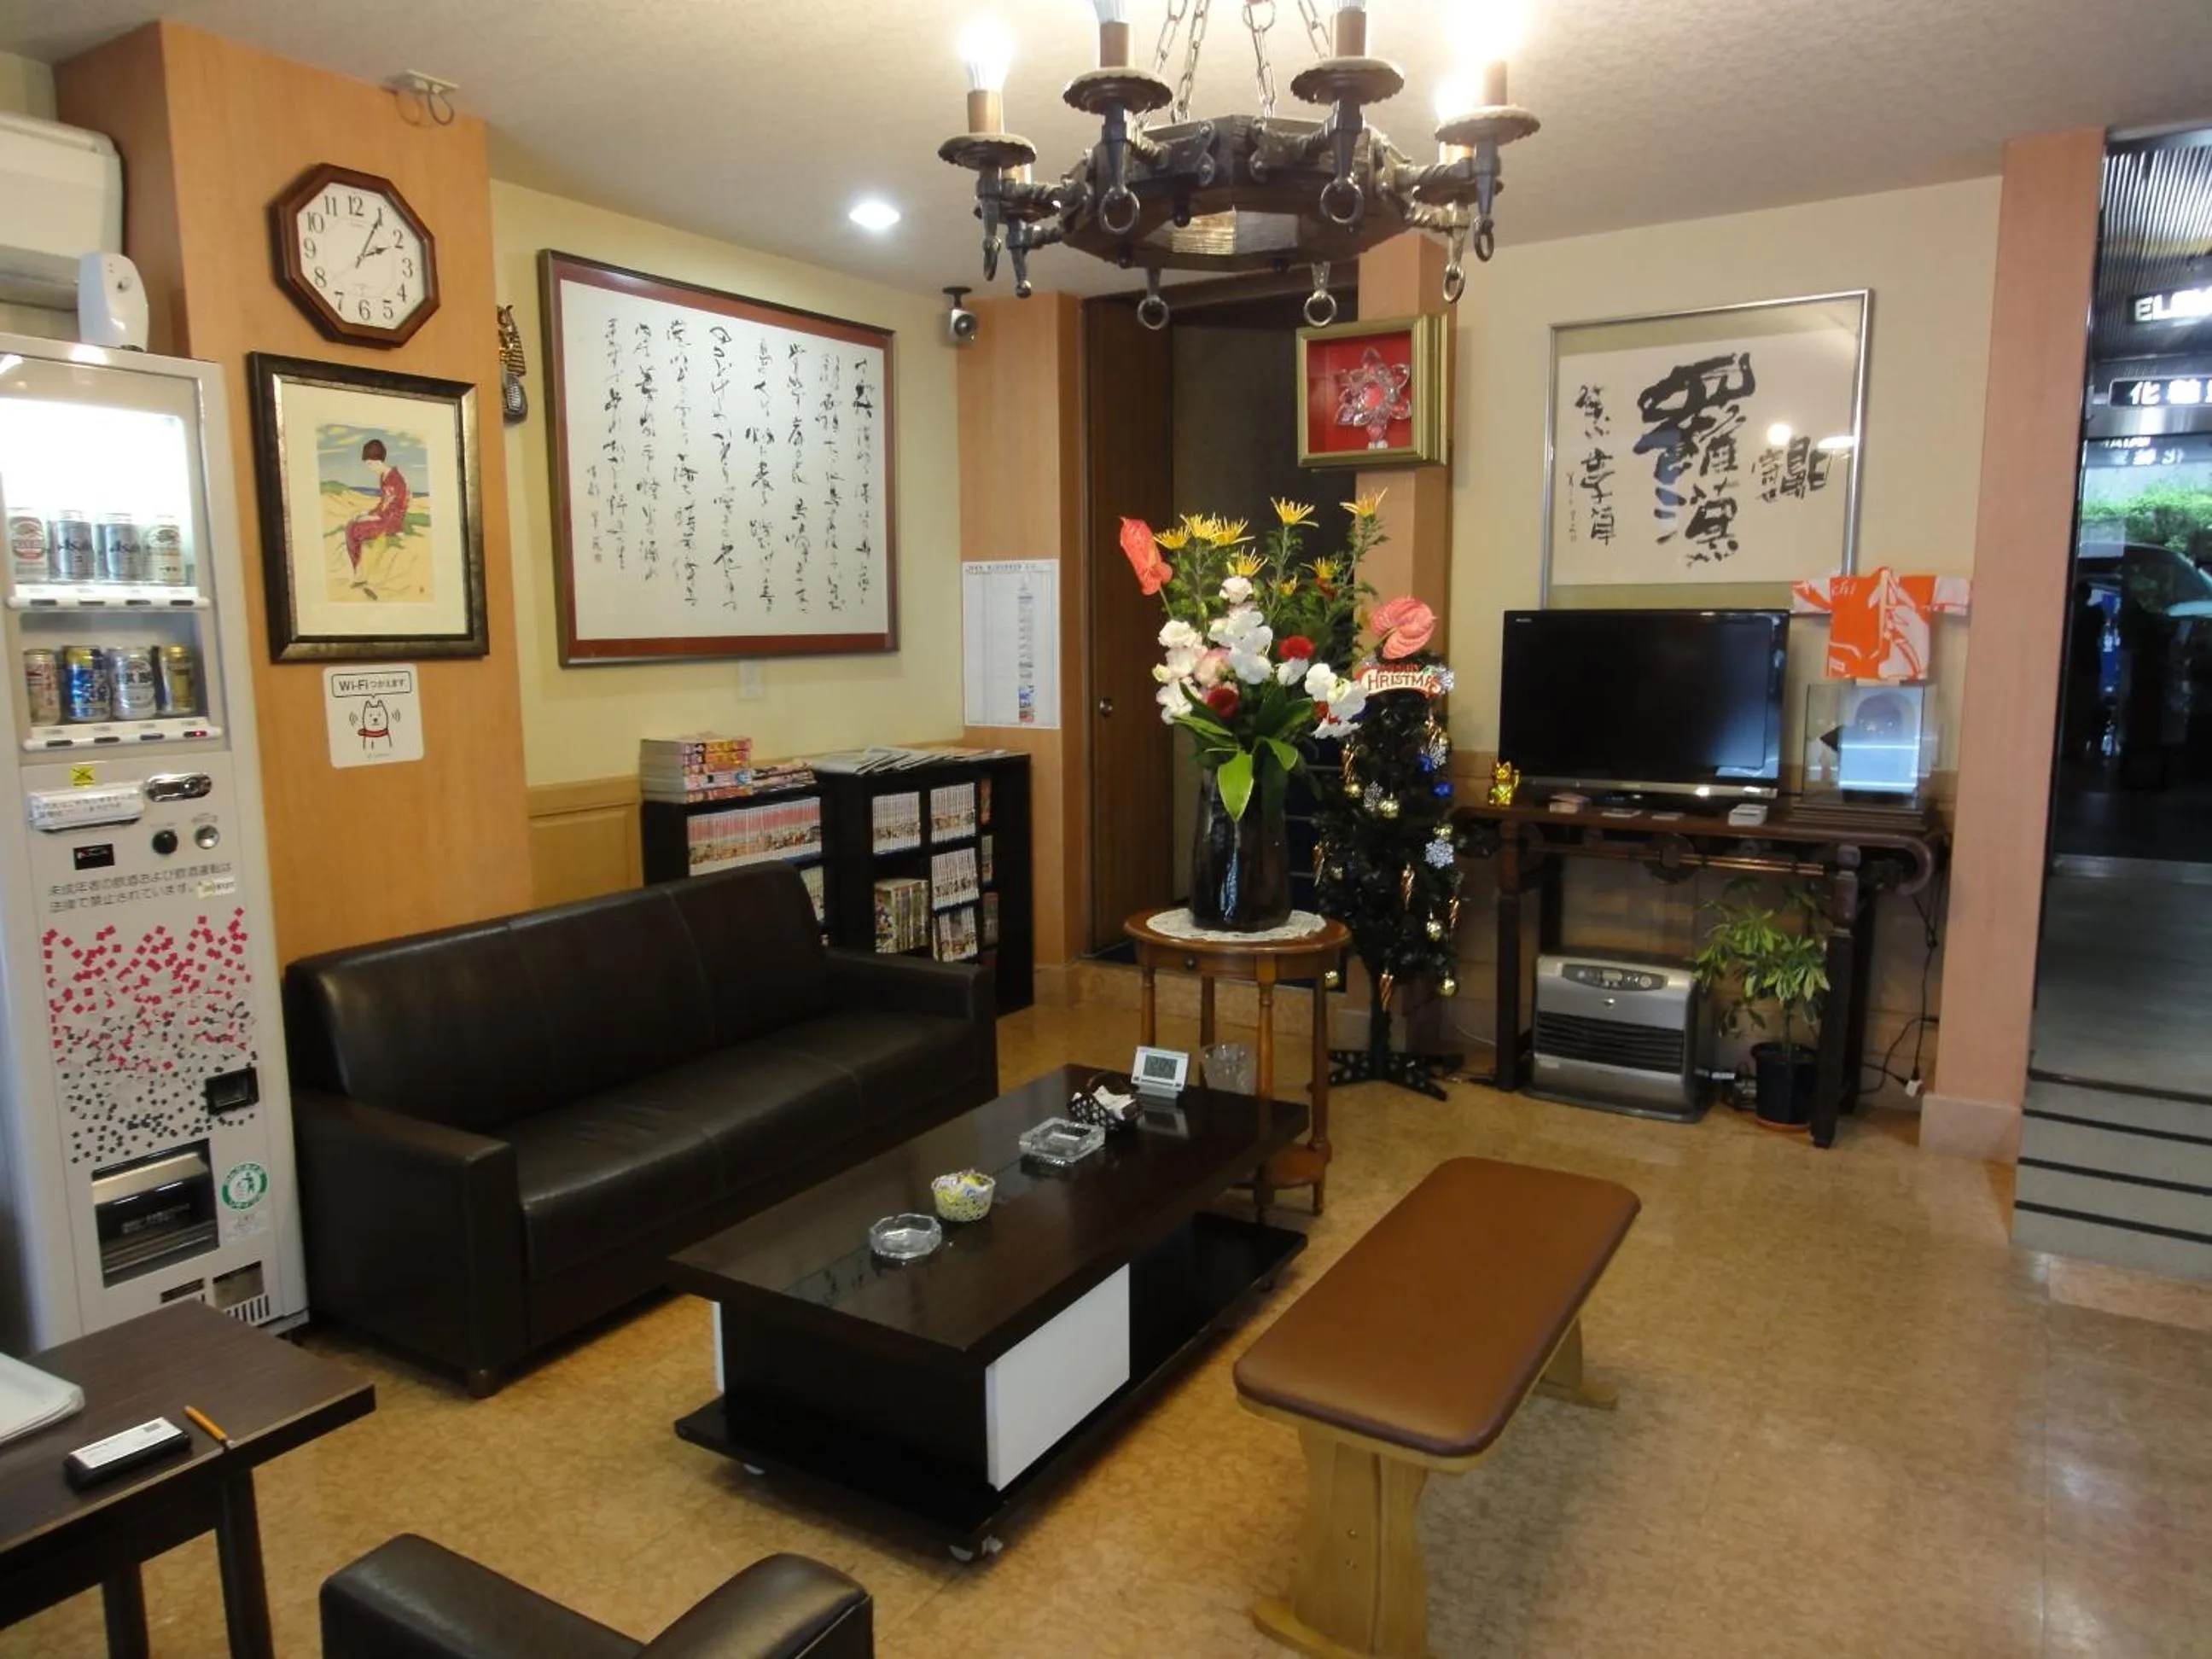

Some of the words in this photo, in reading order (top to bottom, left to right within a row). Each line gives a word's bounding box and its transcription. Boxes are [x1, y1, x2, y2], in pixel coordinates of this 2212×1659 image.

[324, 195, 338, 217] 11
[348, 195, 364, 217] 12
[377, 207, 384, 226] 1
[307, 212, 325, 234] 10
[303, 237, 317, 259] 9
[393, 229, 405, 249] 2
[314, 266, 328, 288] 8
[402, 258, 414, 278] 3
[334, 291, 345, 311] 7
[397, 282, 407, 303] 4
[358, 300, 371, 321] 6
[382, 300, 394, 320] 5
